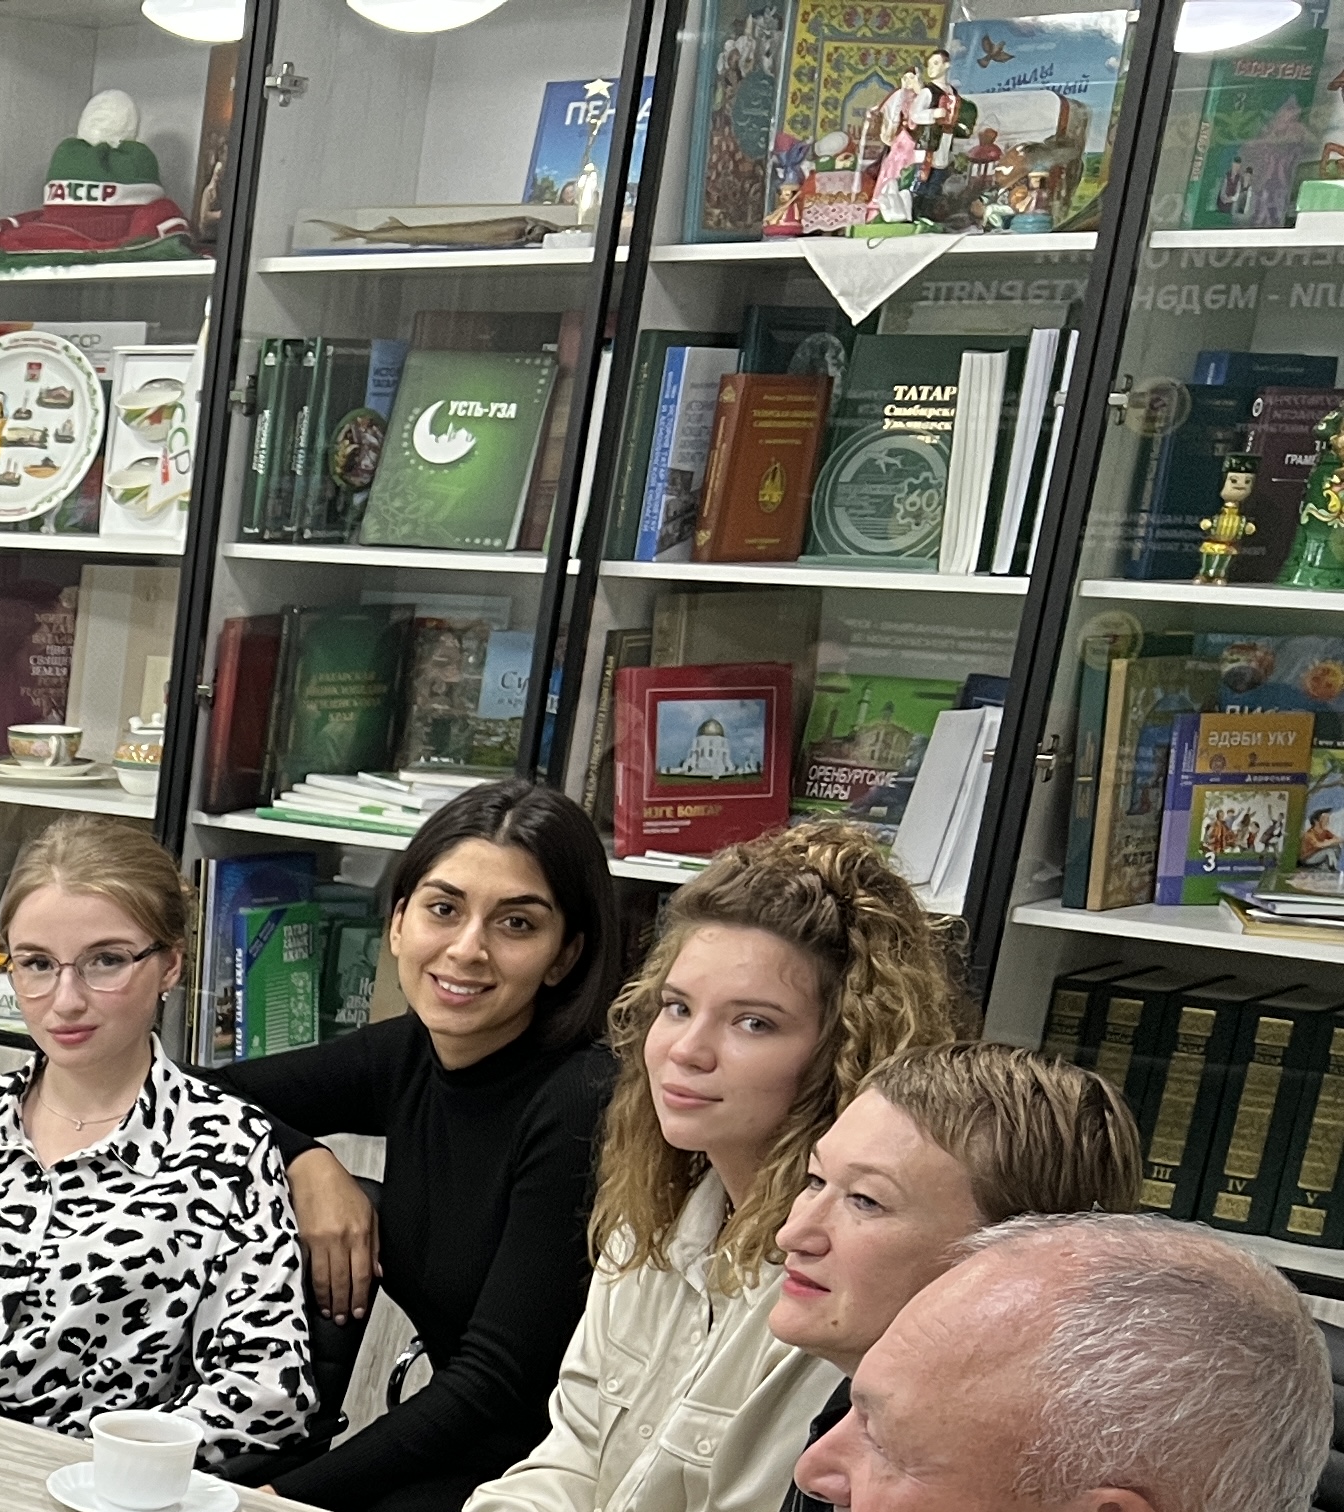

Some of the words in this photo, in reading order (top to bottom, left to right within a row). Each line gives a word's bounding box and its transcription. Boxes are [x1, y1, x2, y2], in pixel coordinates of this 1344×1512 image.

[893, 385, 958, 401] ТАТАР
[448, 401, 517, 418] УСТЬ-УЗА
[905, 488, 940, 512] 60
[1208, 731, 1262, 748] ӘДӘБИ
[1267, 731, 1297, 746] УКУ
[808, 765, 899, 788] ОРЕНБУРГСКИЕ
[805, 781, 852, 800] ТАТАРЫ
[1228, 1179, 1247, 1192] IV
